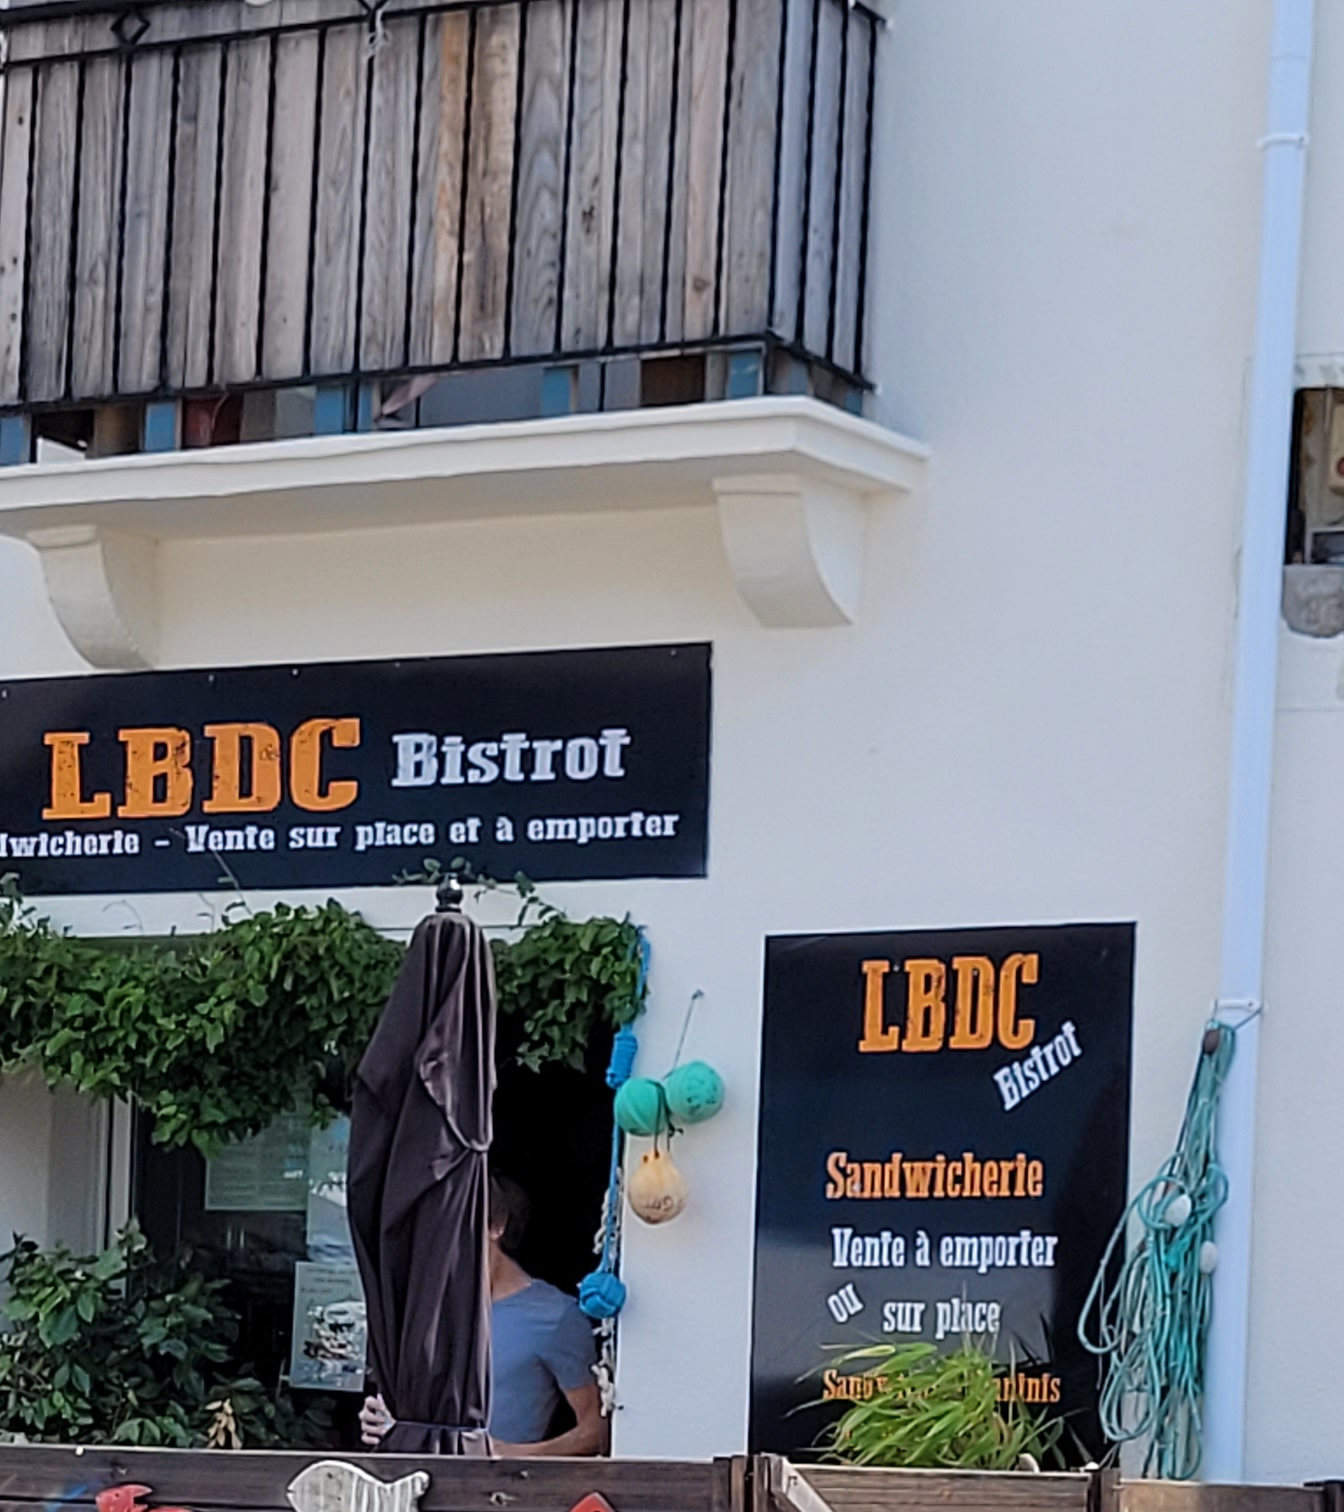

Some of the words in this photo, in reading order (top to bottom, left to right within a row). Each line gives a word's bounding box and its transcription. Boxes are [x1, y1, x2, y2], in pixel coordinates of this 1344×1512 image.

[41, 717, 361, 820] LBDC
[391, 728, 630, 788] Bistrot
[186, 823, 276, 854] Vente
[288, 824, 340, 850] sur
[355, 816, 434, 851] place
[449, 817, 481, 843] et
[496, 813, 513, 841] à
[527, 810, 680, 847] emporter
[858, 952, 1039, 1052] LBDC
[993, 1020, 1083, 1111] Bistrot
[825, 1152, 1044, 1199] Sandwicherie
[831, 1227, 905, 1268] Vente
[915, 1230, 930, 1267] à
[940, 1229, 1059, 1274] emporter
[827, 1283, 864, 1323] ou
[883, 1301, 924, 1332] sur
[935, 1298, 1001, 1340] place
